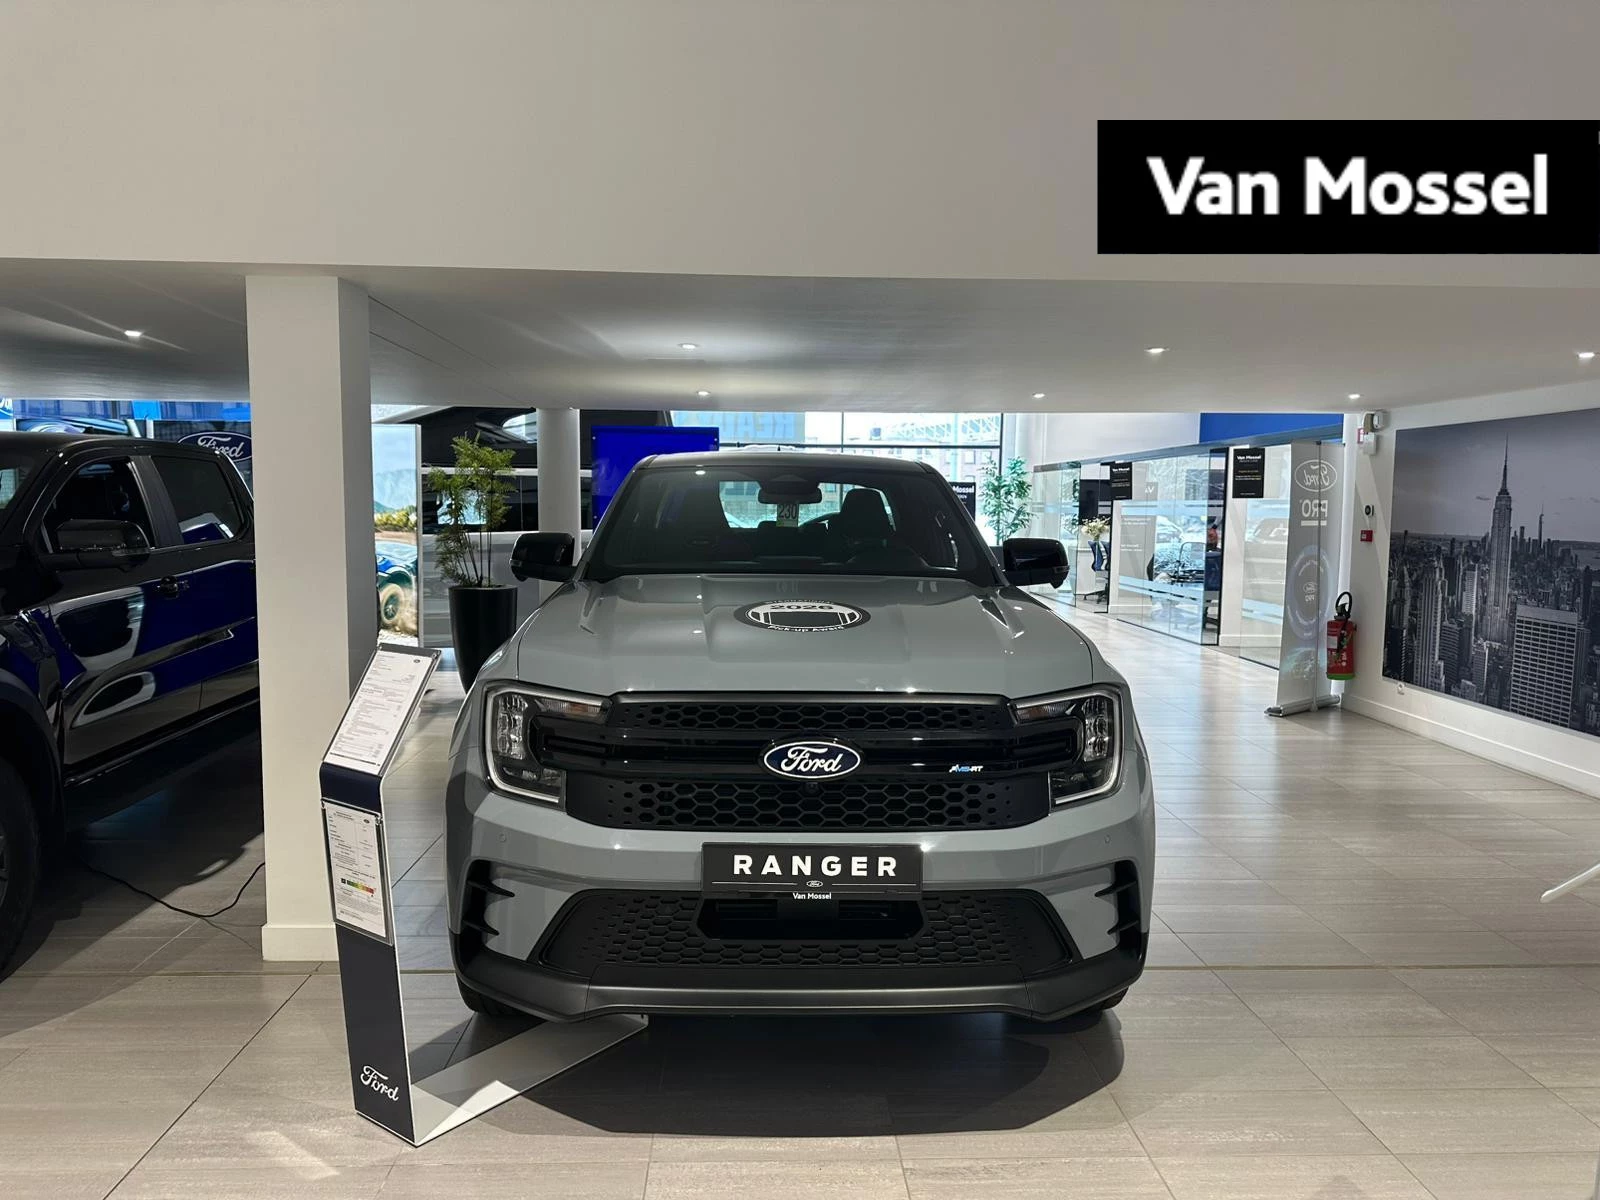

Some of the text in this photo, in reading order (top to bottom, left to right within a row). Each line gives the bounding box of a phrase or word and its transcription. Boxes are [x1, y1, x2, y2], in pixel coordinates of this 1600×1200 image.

[778, 503, 797, 519] 230
[781, 746, 843, 772] Ford
[733, 854, 897, 877] RANGER
[792, 892, 832, 900] Van Mossel
[360, 1065, 399, 1101] Ford
